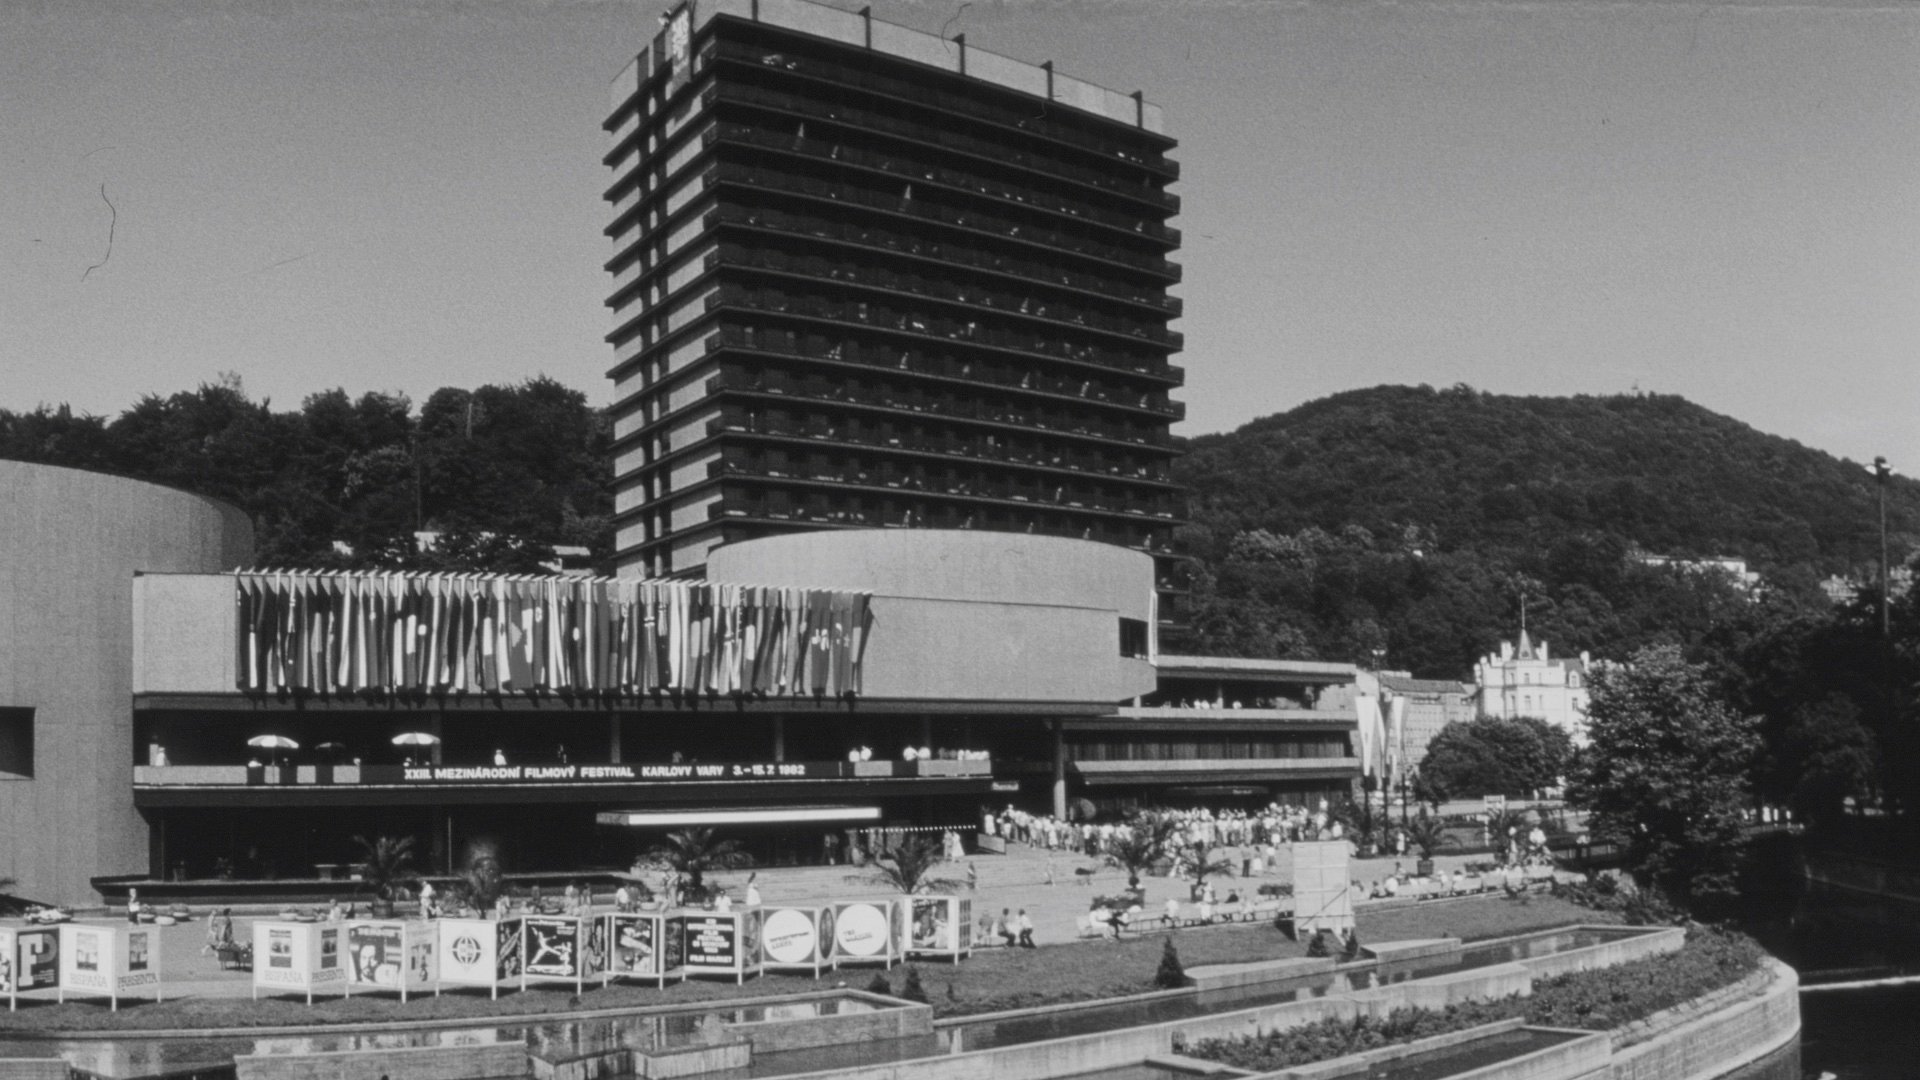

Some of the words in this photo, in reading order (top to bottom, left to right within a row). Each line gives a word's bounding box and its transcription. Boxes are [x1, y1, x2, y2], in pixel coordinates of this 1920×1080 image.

[434, 765, 520, 779] MEZINÁRODNÍ
[524, 765, 576, 778] FILMOVÝ
[580, 766, 635, 778] FESTIVAL
[641, 766, 692, 777] KARLOVY
[696, 765, 724, 776] VARY
[778, 764, 806, 775] 1982
